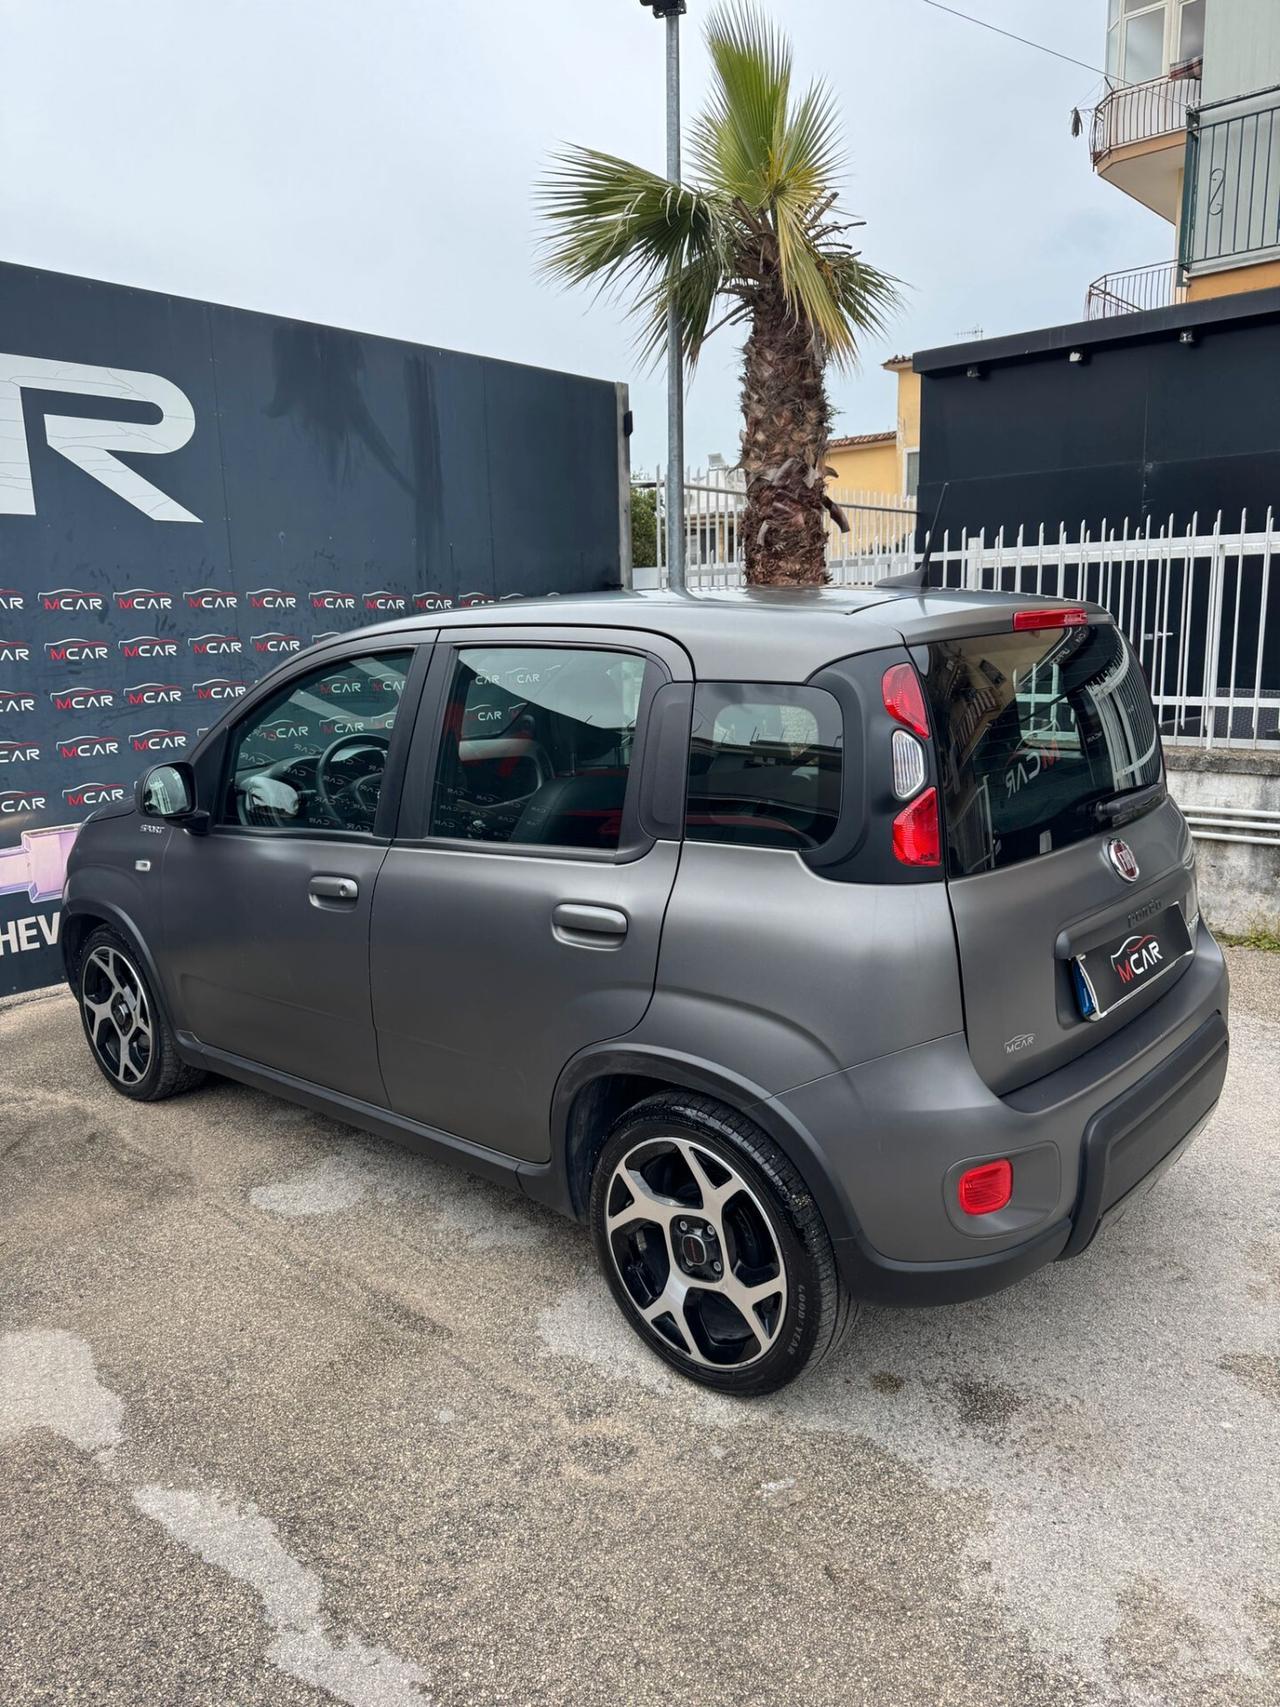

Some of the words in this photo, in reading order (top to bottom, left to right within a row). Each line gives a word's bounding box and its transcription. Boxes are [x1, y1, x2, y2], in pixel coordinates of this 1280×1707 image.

[44, 598, 103, 610] MCAR
[118, 598, 172, 609] MCAR
[188, 597, 238, 609] MCAR
[251, 597, 297, 608] MCAR
[313, 598, 355, 609] MCAR
[366, 598, 405, 609] MCAR
[415, 599, 453, 610] MCAR
[124, 645, 177, 657] MCAR
[193, 642, 242, 654] MCAR
[255, 641, 300, 652] MCAR
[50, 647, 108, 660] MCAR
[128, 691, 182, 704] MCAR
[197, 686, 246, 699] MCAR
[0, 699, 35, 712] AR
[55, 695, 113, 710] MCAR
[133, 736, 187, 751] MCAR
[61, 742, 119, 758] MCAR
[67, 788, 124, 806] MCAR
[1116, 941, 1164, 984] MCAR
[1006, 1036, 1034, 1054] MCAR
